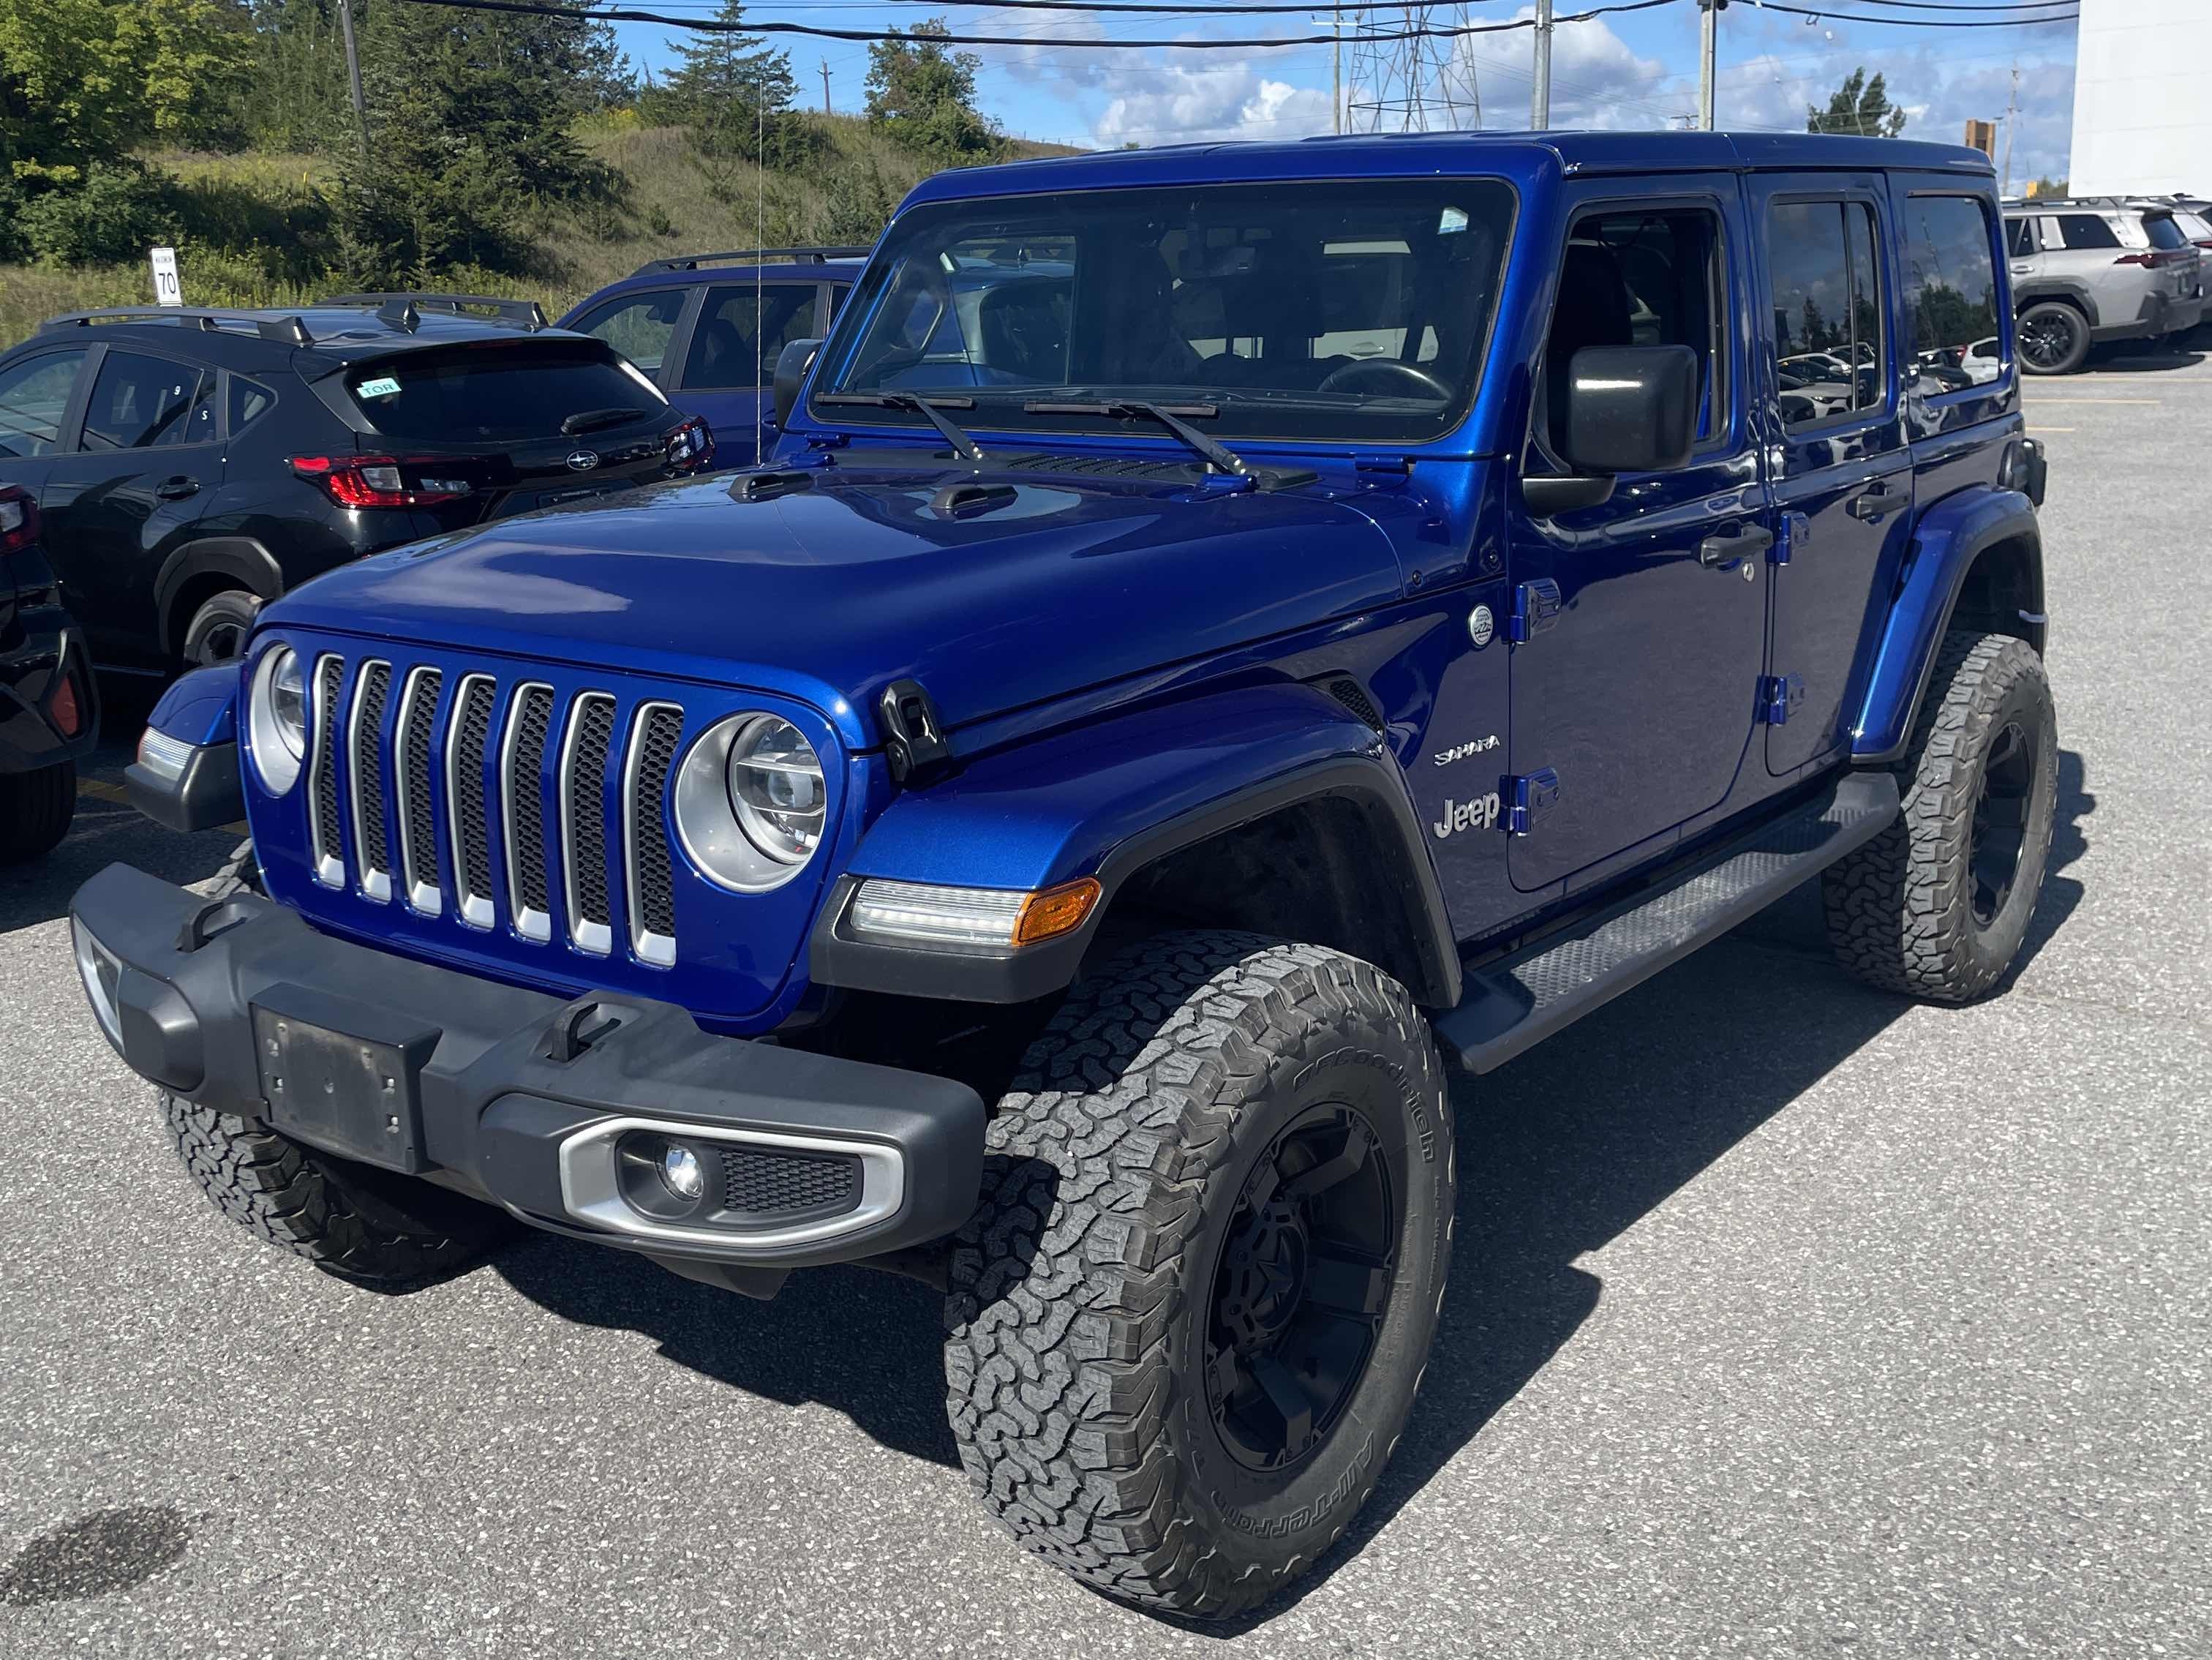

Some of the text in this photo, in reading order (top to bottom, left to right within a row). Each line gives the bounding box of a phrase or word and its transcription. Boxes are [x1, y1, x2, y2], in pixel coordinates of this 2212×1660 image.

[158, 272, 176, 295] 70
[363, 384, 394, 395] TOR
[1434, 735, 1501, 767] SAHARA
[1433, 792, 1500, 838] Jeep
[1293, 1045, 1435, 1163] BFGoodrich
